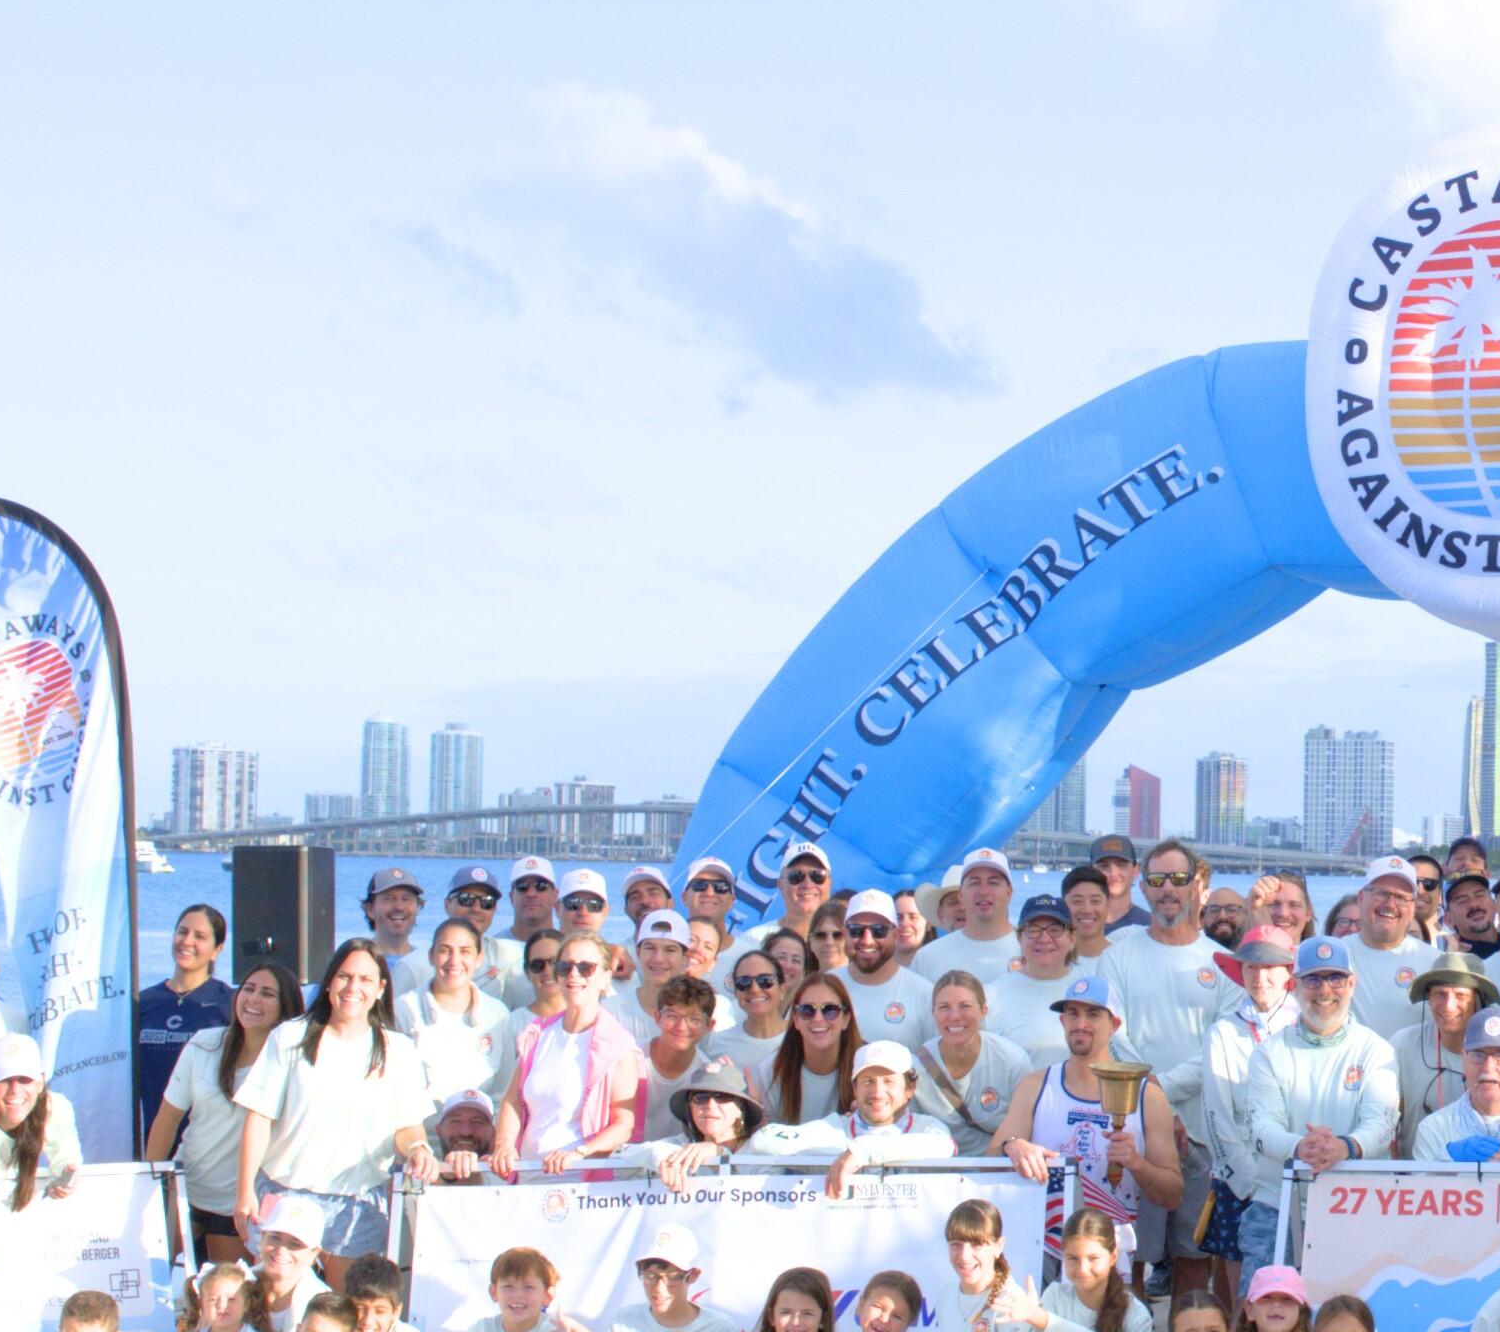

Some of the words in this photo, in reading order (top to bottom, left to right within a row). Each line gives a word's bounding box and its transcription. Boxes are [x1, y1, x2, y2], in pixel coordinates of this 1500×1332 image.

[728, 746, 868, 930] IGHT.
[854, 443, 1225, 746] CELEBRATE.
[577, 1193, 632, 1210] Thank
[636, 1191, 667, 1206] You
[695, 1189, 725, 1204] Our
[730, 1188, 817, 1207] Sponsors
[1328, 1187, 1368, 1216] 27
[1375, 1188, 1484, 1217] YEARS
[82, 1247, 121, 1262] BERGER
